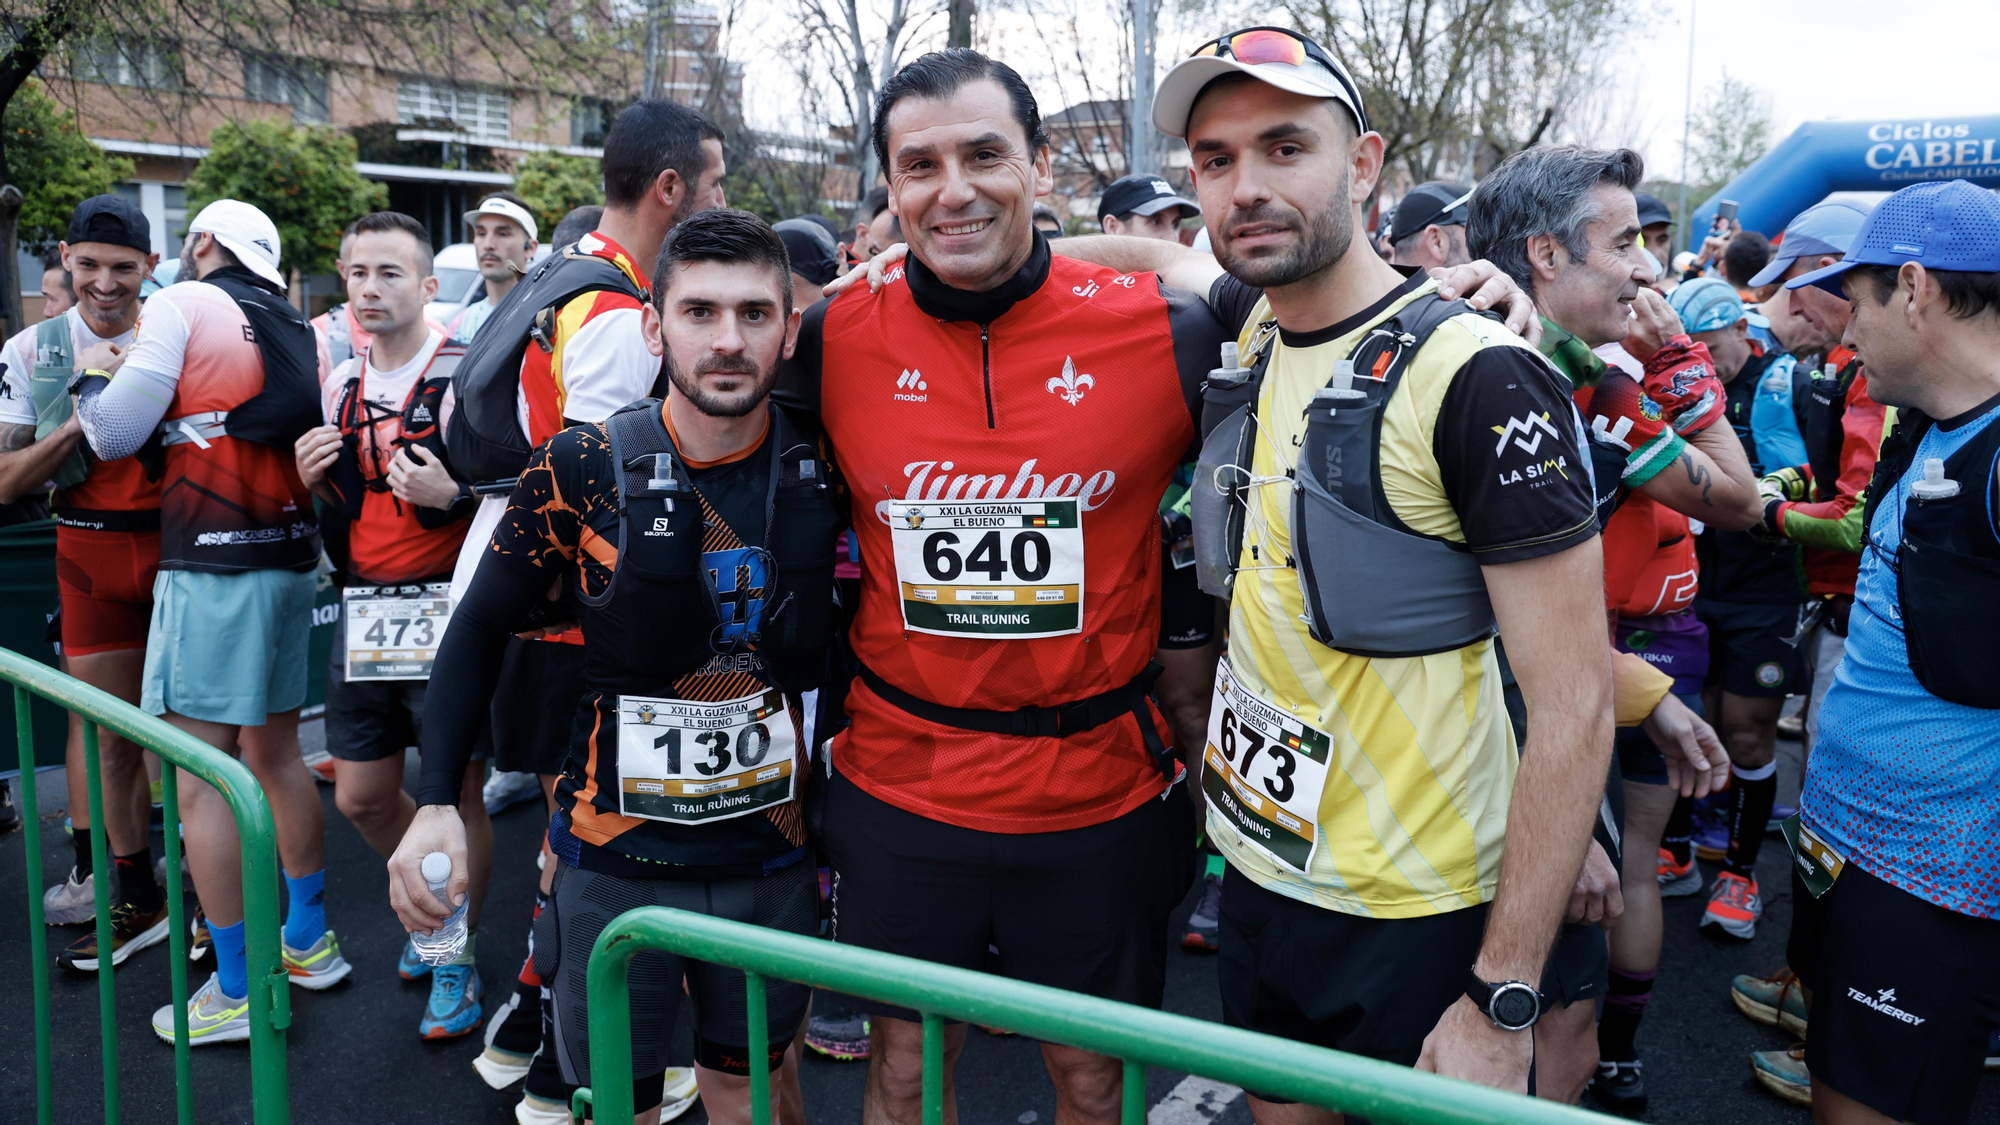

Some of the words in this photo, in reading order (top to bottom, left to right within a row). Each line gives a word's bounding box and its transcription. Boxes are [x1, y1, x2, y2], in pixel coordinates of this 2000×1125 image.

[1867, 121, 1969, 142] Ciclos
[893, 393, 928, 402] mobel
[1499, 469, 1523, 486] LA
[1525, 455, 1569, 480] SIMA
[1530, 479, 1553, 489] TRAIL
[939, 507, 957, 515] XXI
[959, 507, 972, 515] LA
[974, 504, 1022, 515] GUZMÁN
[953, 518, 966, 527] EL
[968, 517, 1005, 527] BUENO
[922, 530, 1052, 582] 640
[946, 613, 979, 625] TRAIL
[982, 614, 1030, 625] RUNING
[364, 618, 435, 647] 473
[671, 706, 688, 716] XXI
[689, 708, 702, 717] LA
[704, 703, 748, 717] GUZMÁN
[1236, 704, 1245, 716] EL
[1244, 712, 1268, 731] BUENO
[1239, 693, 1249, 707] LA
[1248, 700, 1284, 726] GUZMÁN
[683, 718, 695, 728] EL
[697, 717, 733, 728] BUENO
[654, 722, 771, 776] 130
[1220, 707, 1296, 803] 673
[672, 803, 705, 814] TRAIL
[709, 795, 751, 811] RUNING
[1221, 790, 1238, 816] TRAIL
[1237, 808, 1272, 840] RUNING
[1847, 987, 1926, 1026] TEAMERGY
